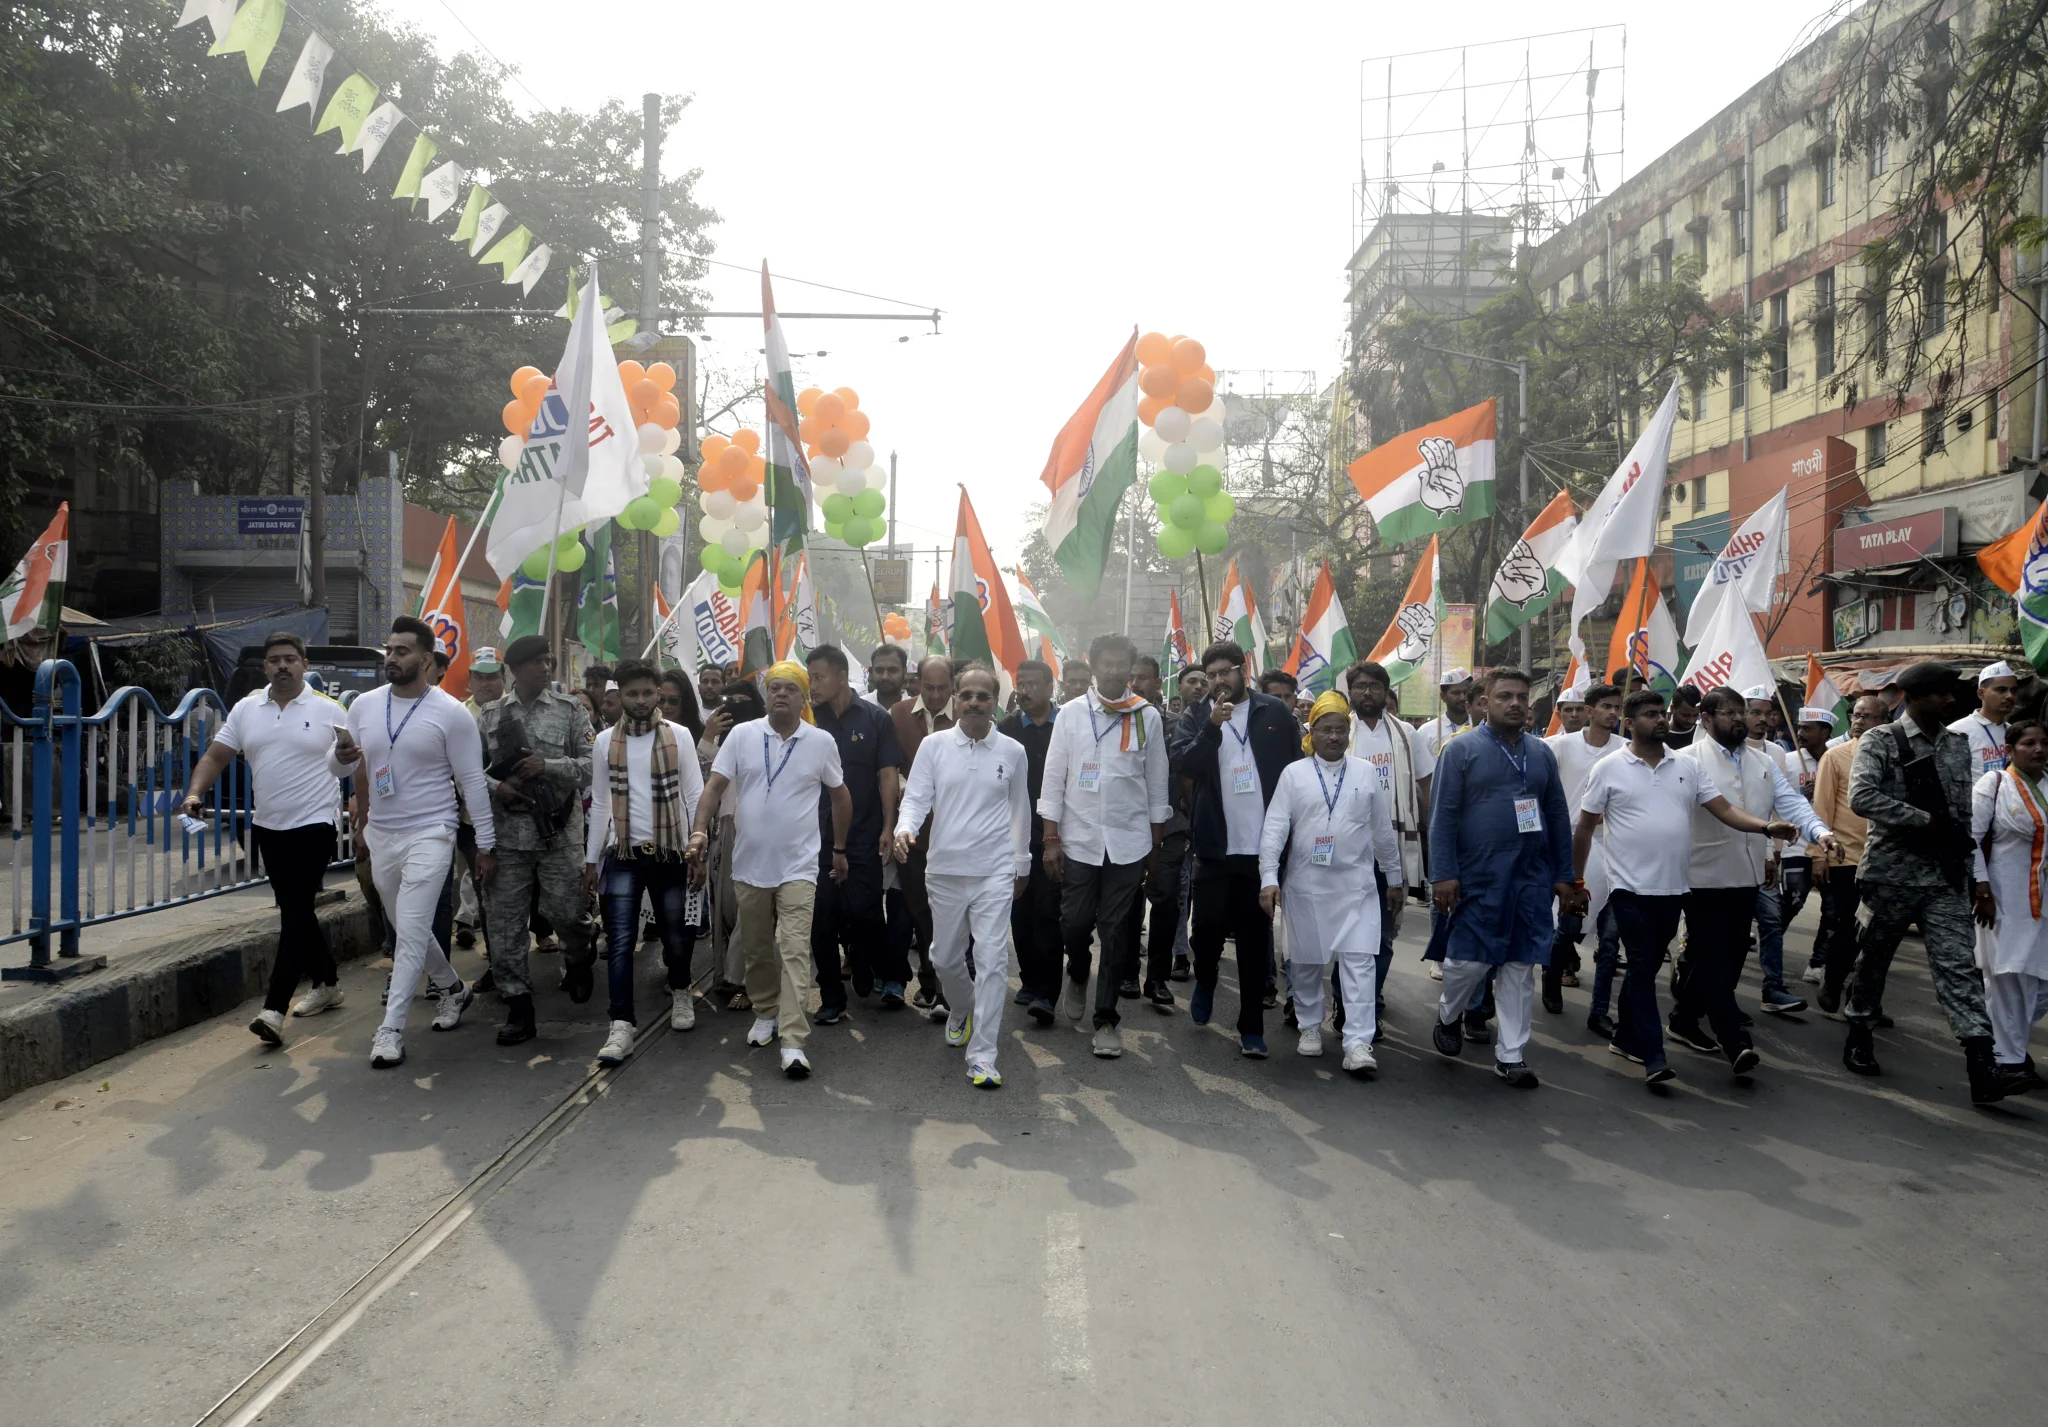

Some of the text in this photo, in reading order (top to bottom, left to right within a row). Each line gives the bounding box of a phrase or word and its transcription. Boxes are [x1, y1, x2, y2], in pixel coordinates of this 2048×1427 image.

[1860, 527, 1912, 549] TATA PLAY
[876, 568, 904, 576] SERUM
[1362, 752, 1392, 766] ARAT
[1234, 764, 1251, 775] BHARAT
[1236, 781, 1250, 792] YATRA
[1516, 800, 1535, 812] BHARAT
[1520, 820, 1535, 831] YATRA
[1315, 836, 1333, 844] BHARAT
